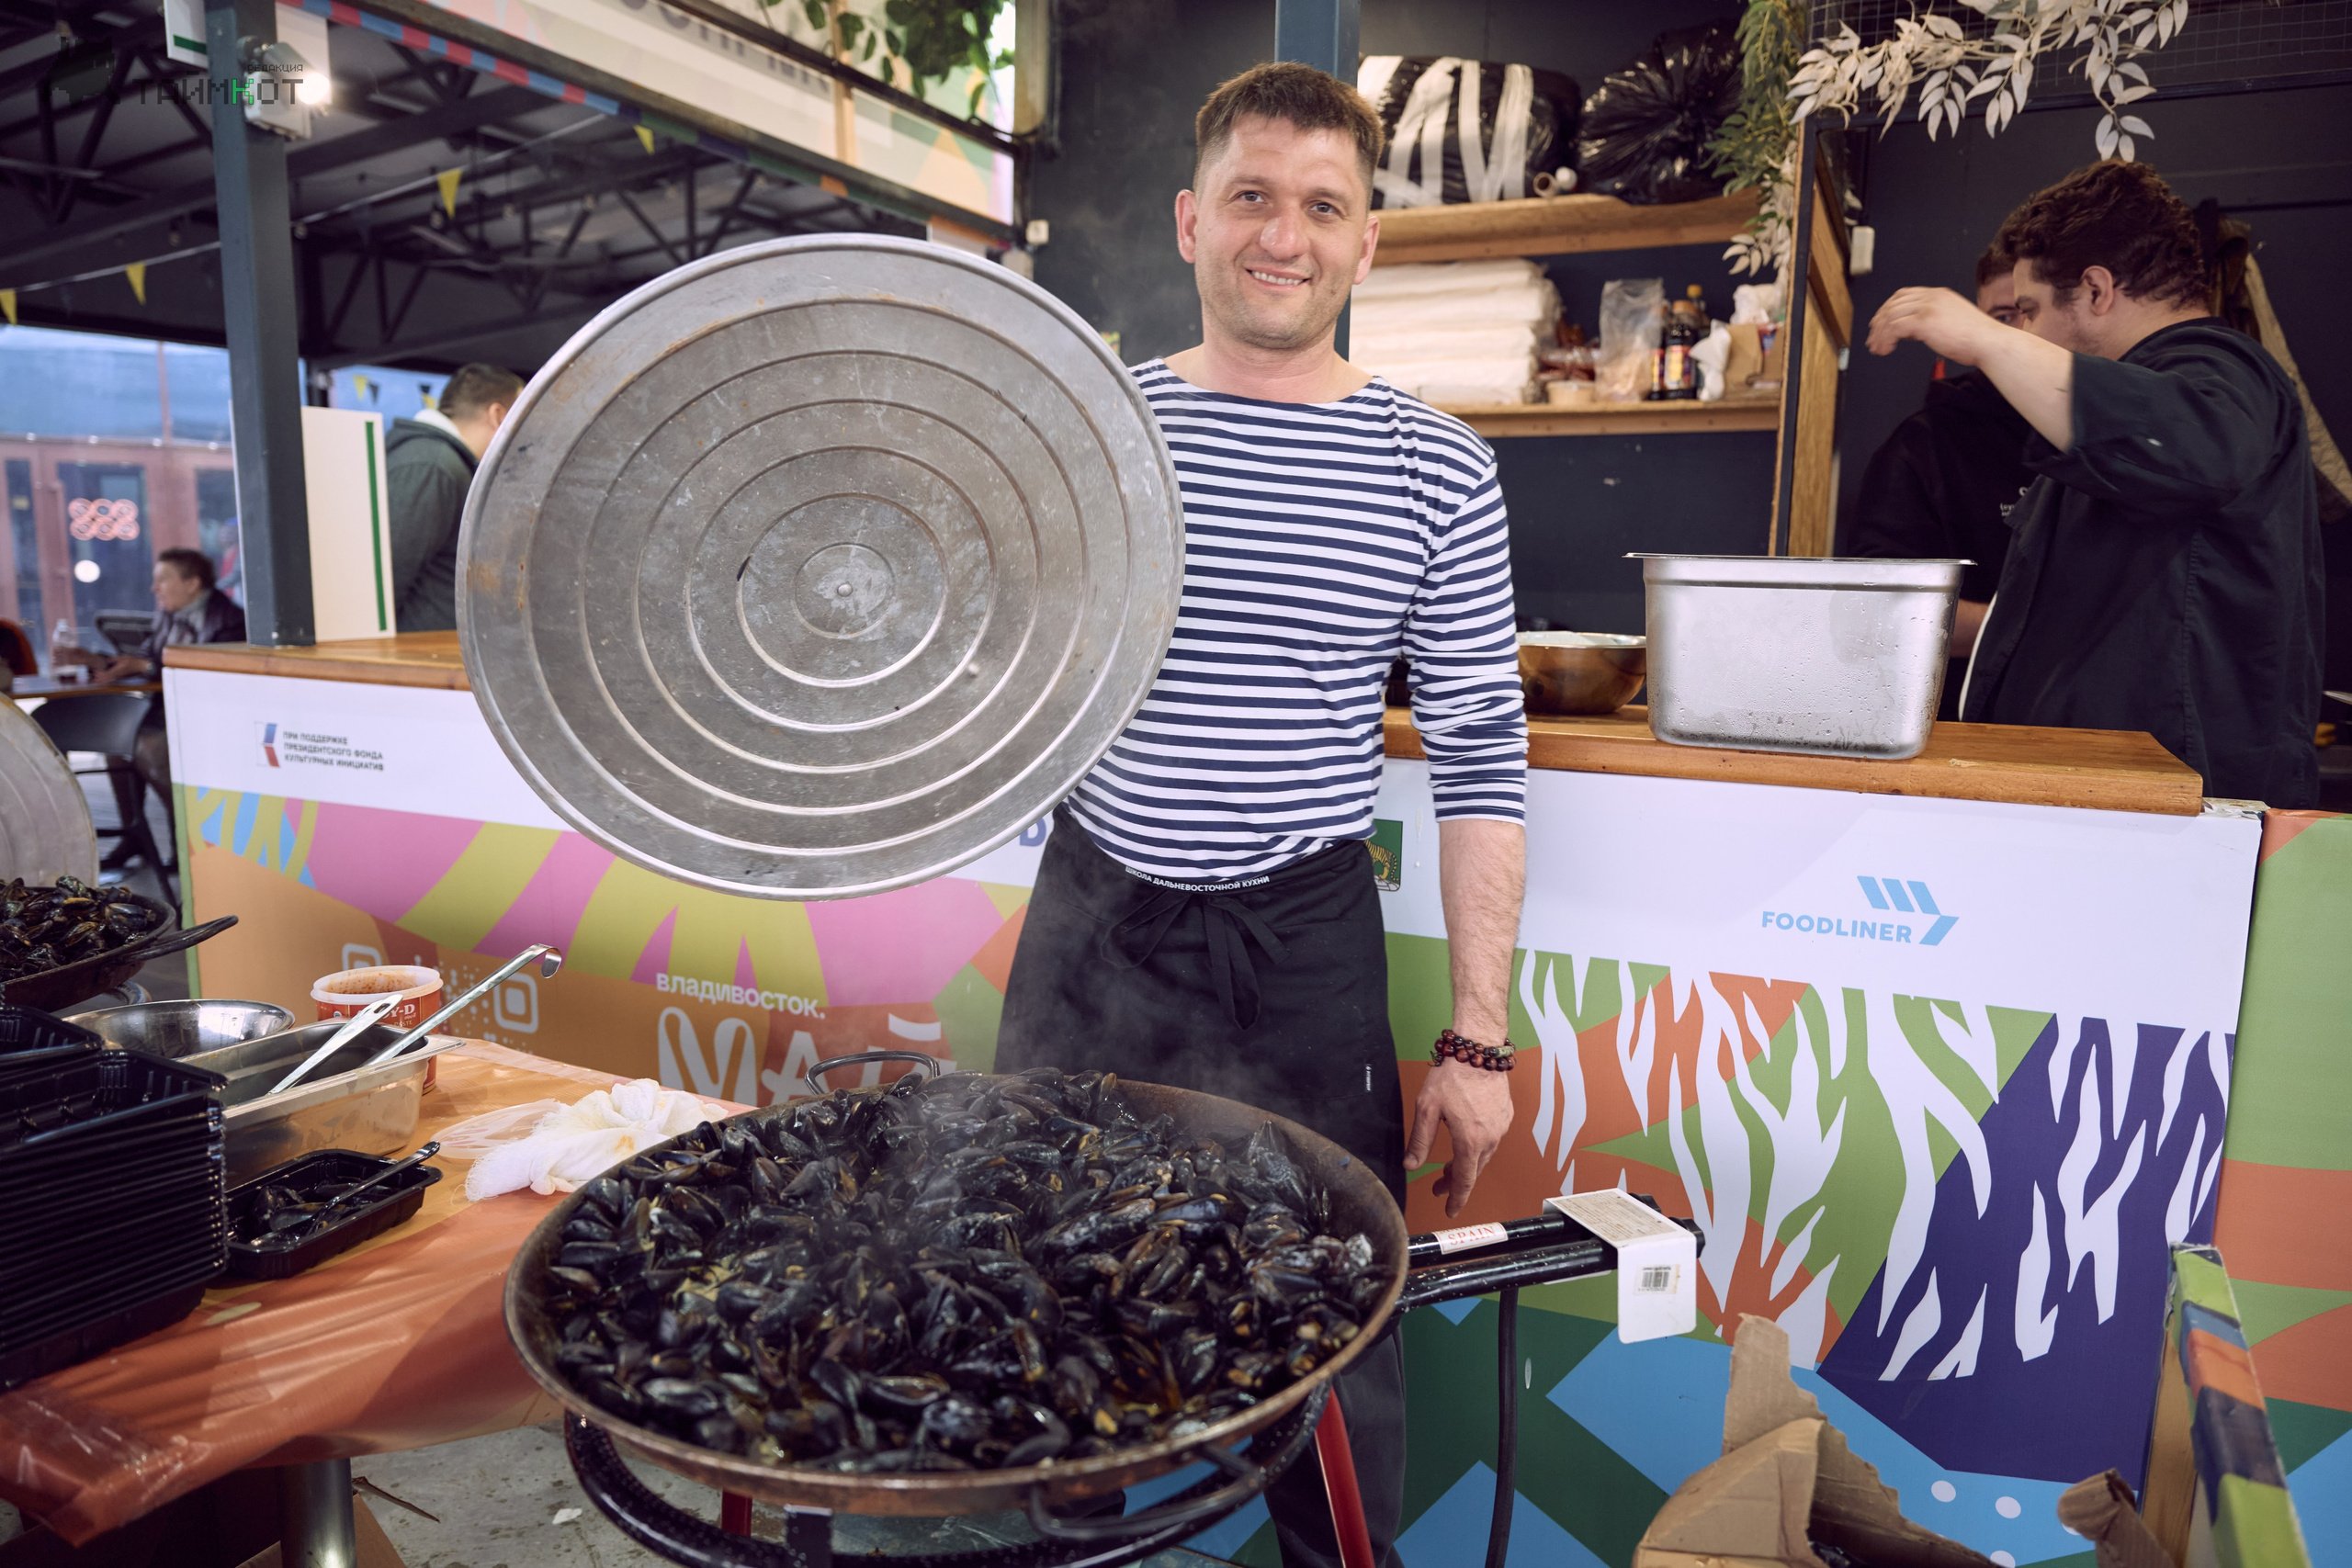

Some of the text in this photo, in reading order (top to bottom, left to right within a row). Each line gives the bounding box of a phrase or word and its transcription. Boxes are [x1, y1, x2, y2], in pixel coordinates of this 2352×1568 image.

[283, 730, 348, 745] ПРИ ПОДДЕРЖКЕ
[284, 742, 383, 760] ПРЕЗИДЕНТСКОГО ФОНДА
[285, 753, 384, 772] КУЛЬТУРНЫХ ИНИЦИАТИВ
[1125, 865, 1270, 892] ШКОЛА ДАЛЬНЕВОСТОЧНОЙ КУХНИ
[1761, 910, 1912, 943] FOODLINER
[1448, 1225, 1496, 1246] SPAIN
